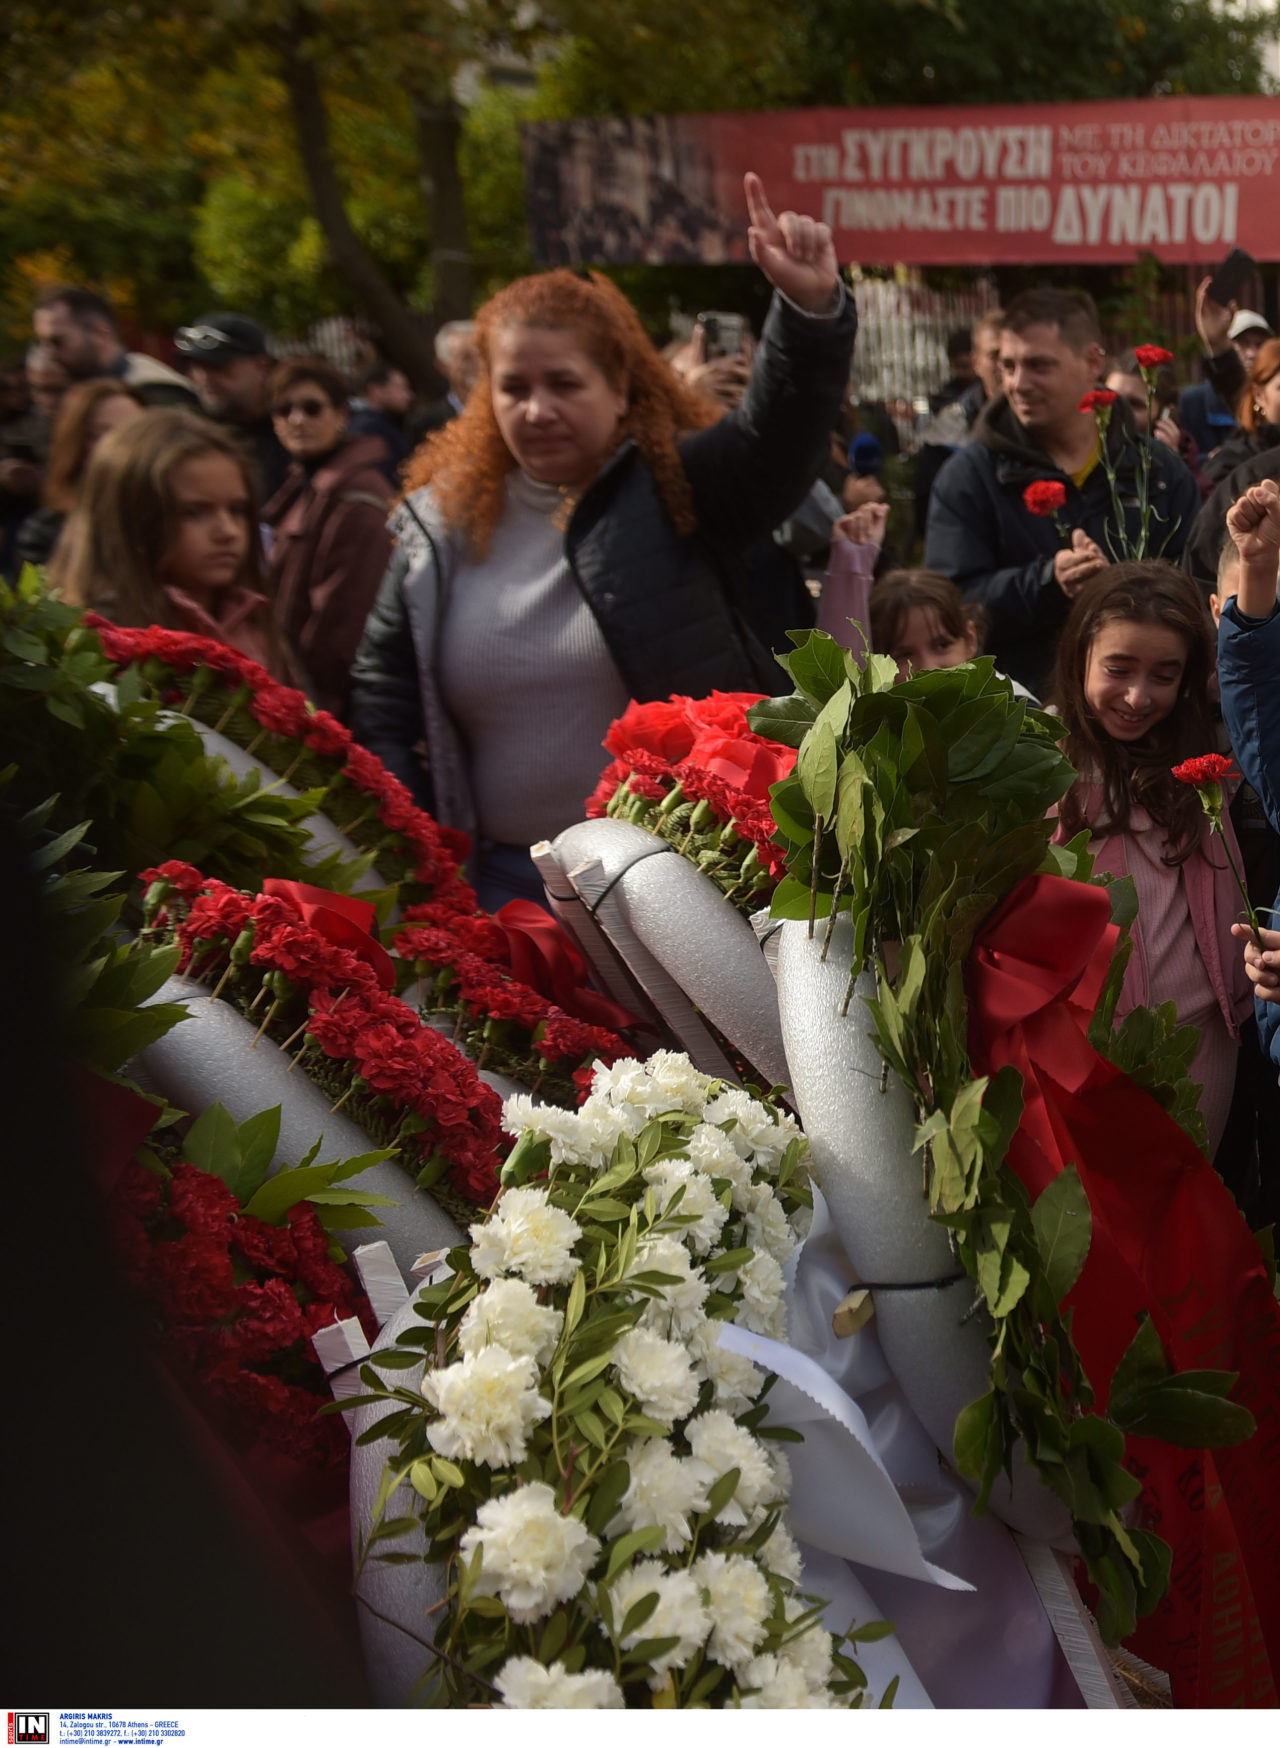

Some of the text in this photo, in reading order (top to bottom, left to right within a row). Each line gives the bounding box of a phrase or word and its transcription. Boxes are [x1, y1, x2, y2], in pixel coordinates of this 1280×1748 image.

[840, 125, 1052, 181] ΣΥΓΚΡΟΥΣΗ
[1058, 150, 1112, 179] ΤΟΥ
[822, 181, 1240, 244] ΓΙΝΟΜΑΣΤΕ ΠΙΟ ΔΥΝΑΤΟΙ
